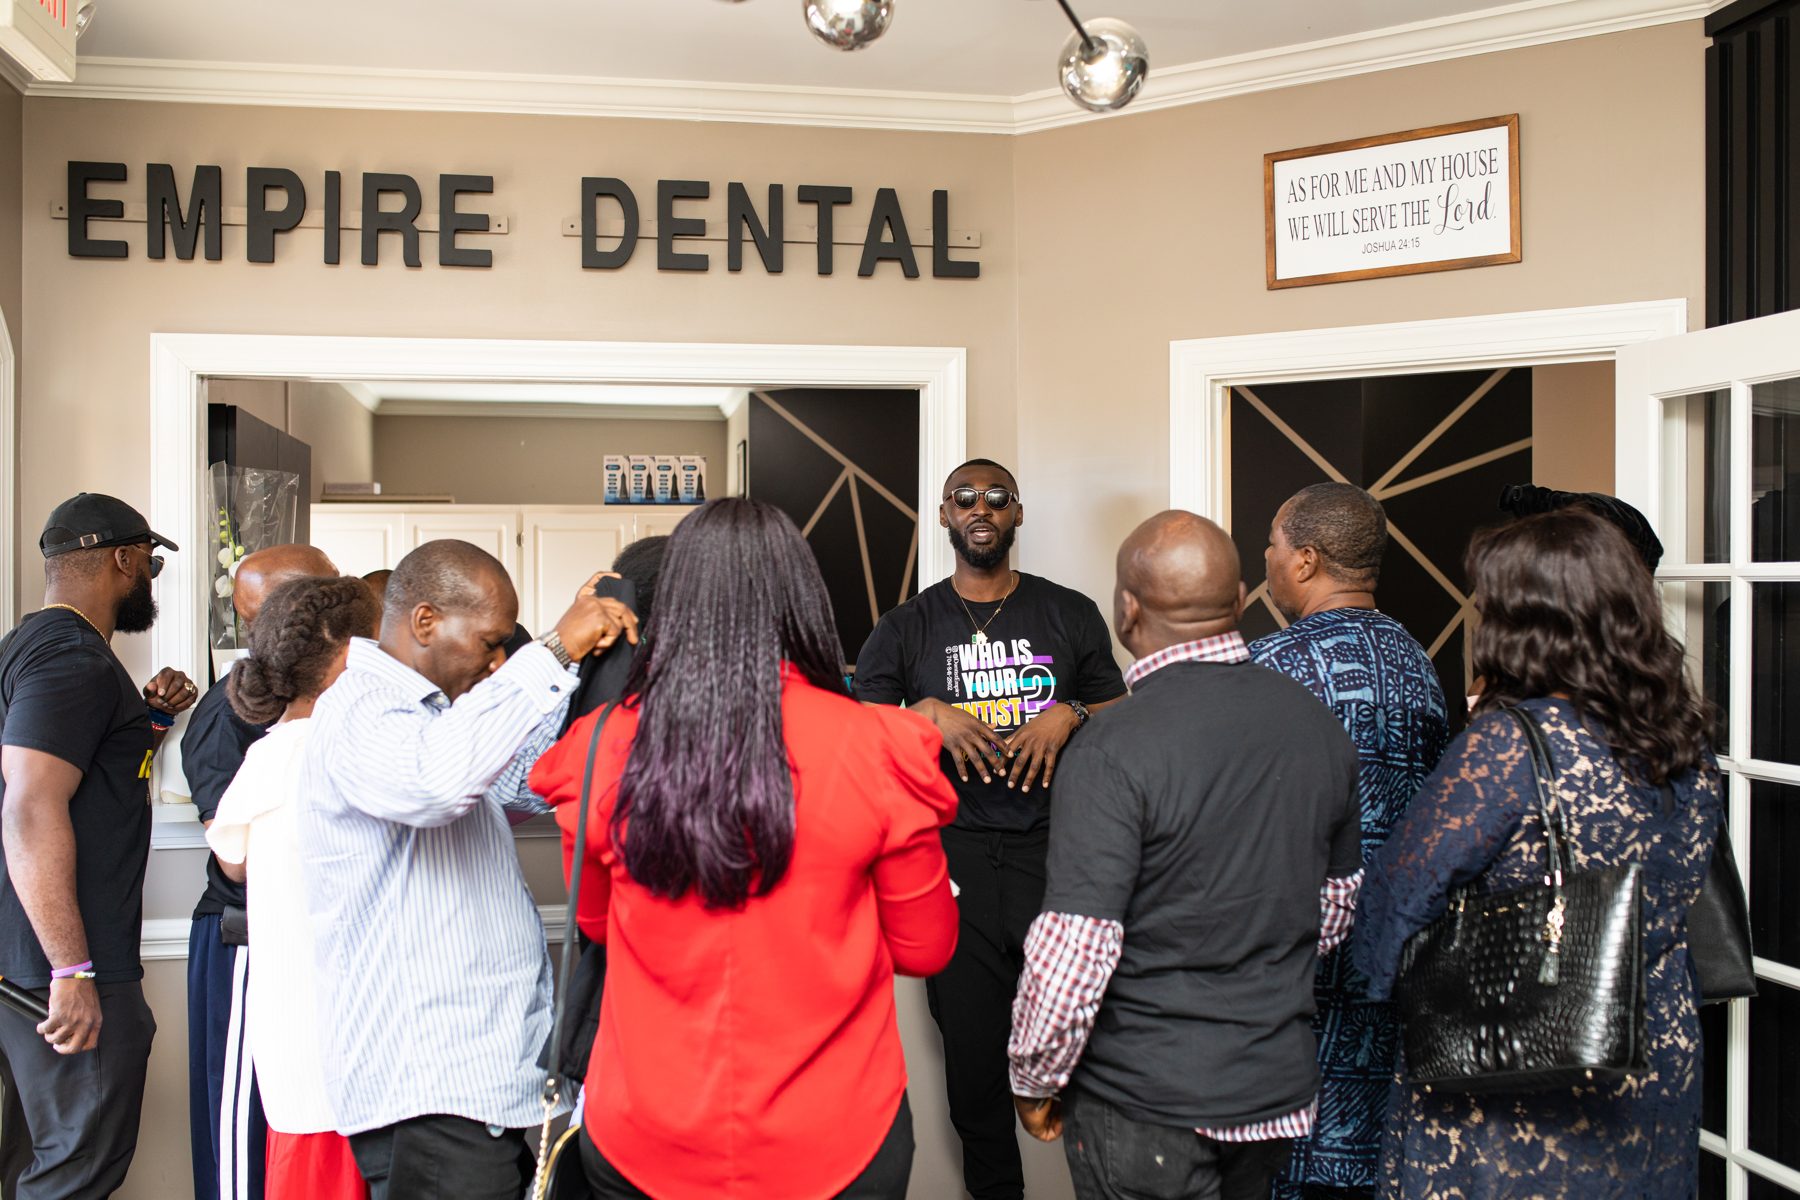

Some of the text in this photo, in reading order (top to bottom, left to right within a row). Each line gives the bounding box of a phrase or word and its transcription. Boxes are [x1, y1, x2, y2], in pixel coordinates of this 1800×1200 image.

[1288, 147, 1498, 203] AS FOR ME AND MY HOUSE
[67, 161, 980, 278] EMPIRE DENTAL
[1288, 215, 1310, 242] WE
[1313, 210, 1349, 238] WILL
[1352, 203, 1397, 233] SERVE
[1402, 199, 1430, 227] THE
[1362, 237, 1420, 254] JOSHUA 24:15
[958, 639, 1033, 671] WHO IS
[961, 668, 1018, 699] YOUR
